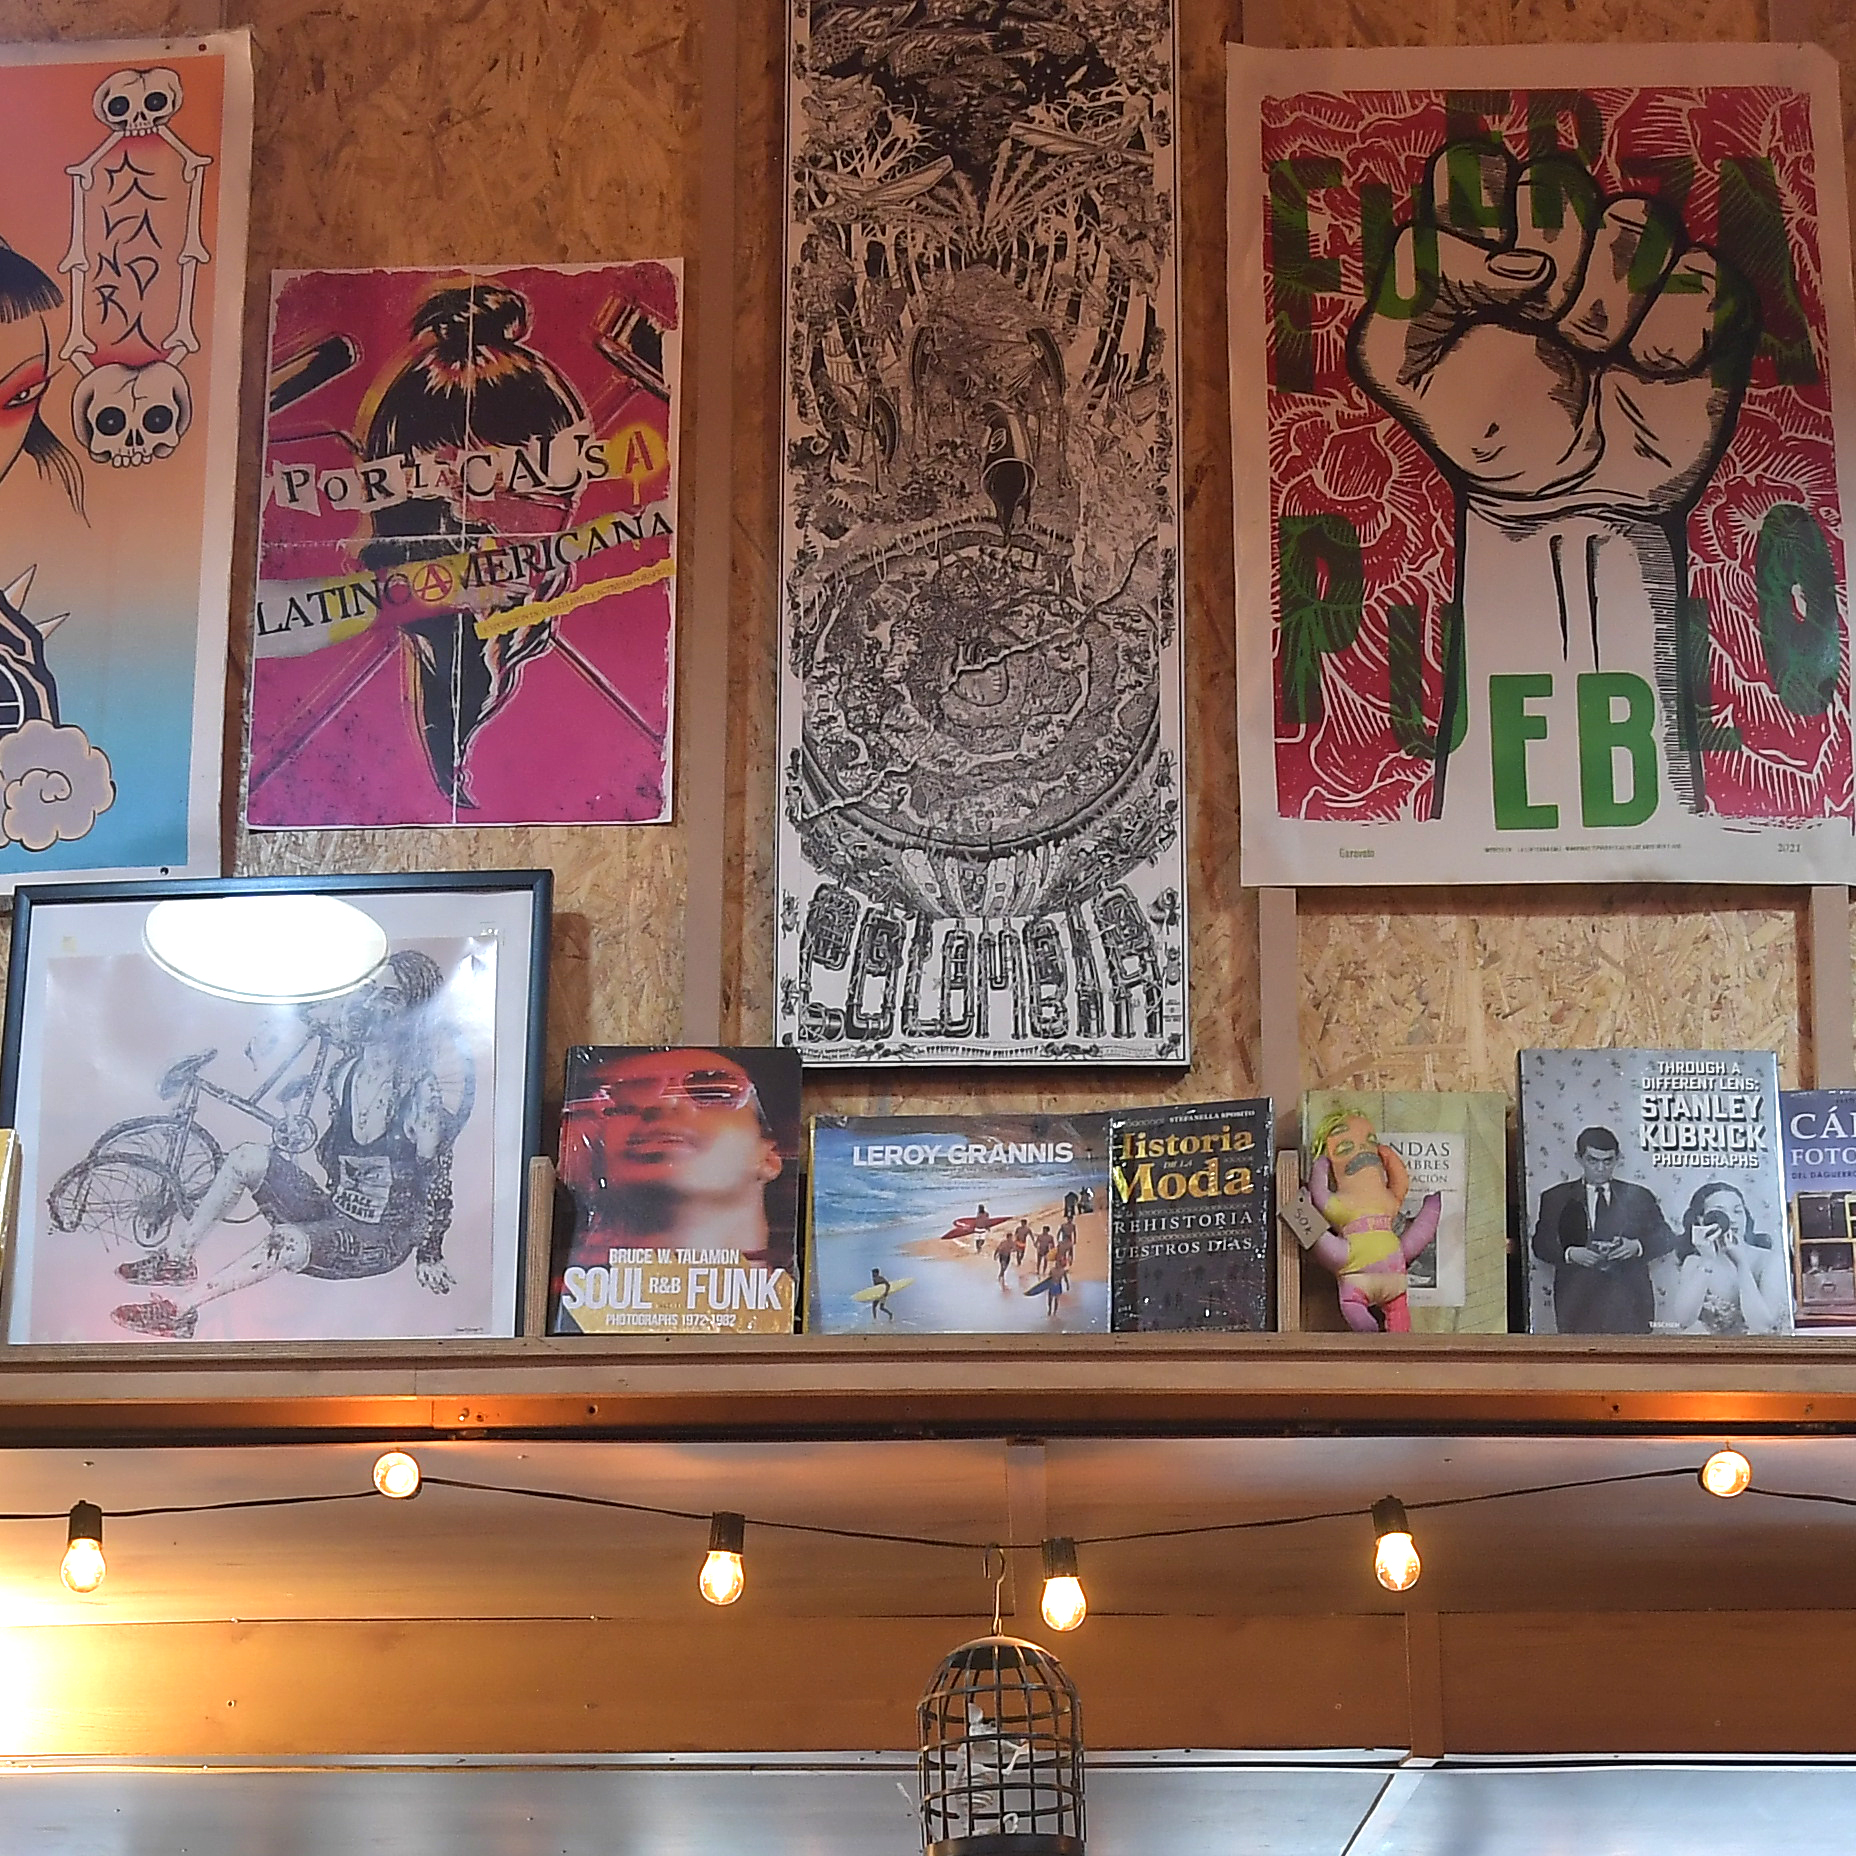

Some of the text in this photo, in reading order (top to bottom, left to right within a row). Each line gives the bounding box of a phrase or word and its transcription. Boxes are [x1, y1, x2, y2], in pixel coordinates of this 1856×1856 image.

[1266, 90, 1816, 395] FUERZA
[282, 431, 654, 504] POR LA CAUSA
[256, 512, 675, 637] LATINOAMERICANA
[1280, 502, 1844, 832] PUEBLO
[798, 880, 1164, 1043] COLOMBIA
[1657, 1061, 1742, 1077] THROUGH A
[1641, 1076, 1761, 1093] DIFFERENT LENS:
[1640, 1094, 1765, 1123] STANLEY
[1639, 1122, 1767, 1152] KUBRICK
[852, 1140, 1075, 1168] LEROY GRANNIS
[1651, 1152, 1760, 1170] PHOTOGRAPHS
[1111, 1157, 1256, 1204] Moda
[609, 1247, 742, 1264] BRUCE W. TALAMON
[560, 1266, 785, 1311] SOUL R&B FUNK
[604, 1312, 679, 1327] PHOTOGRAPHS
